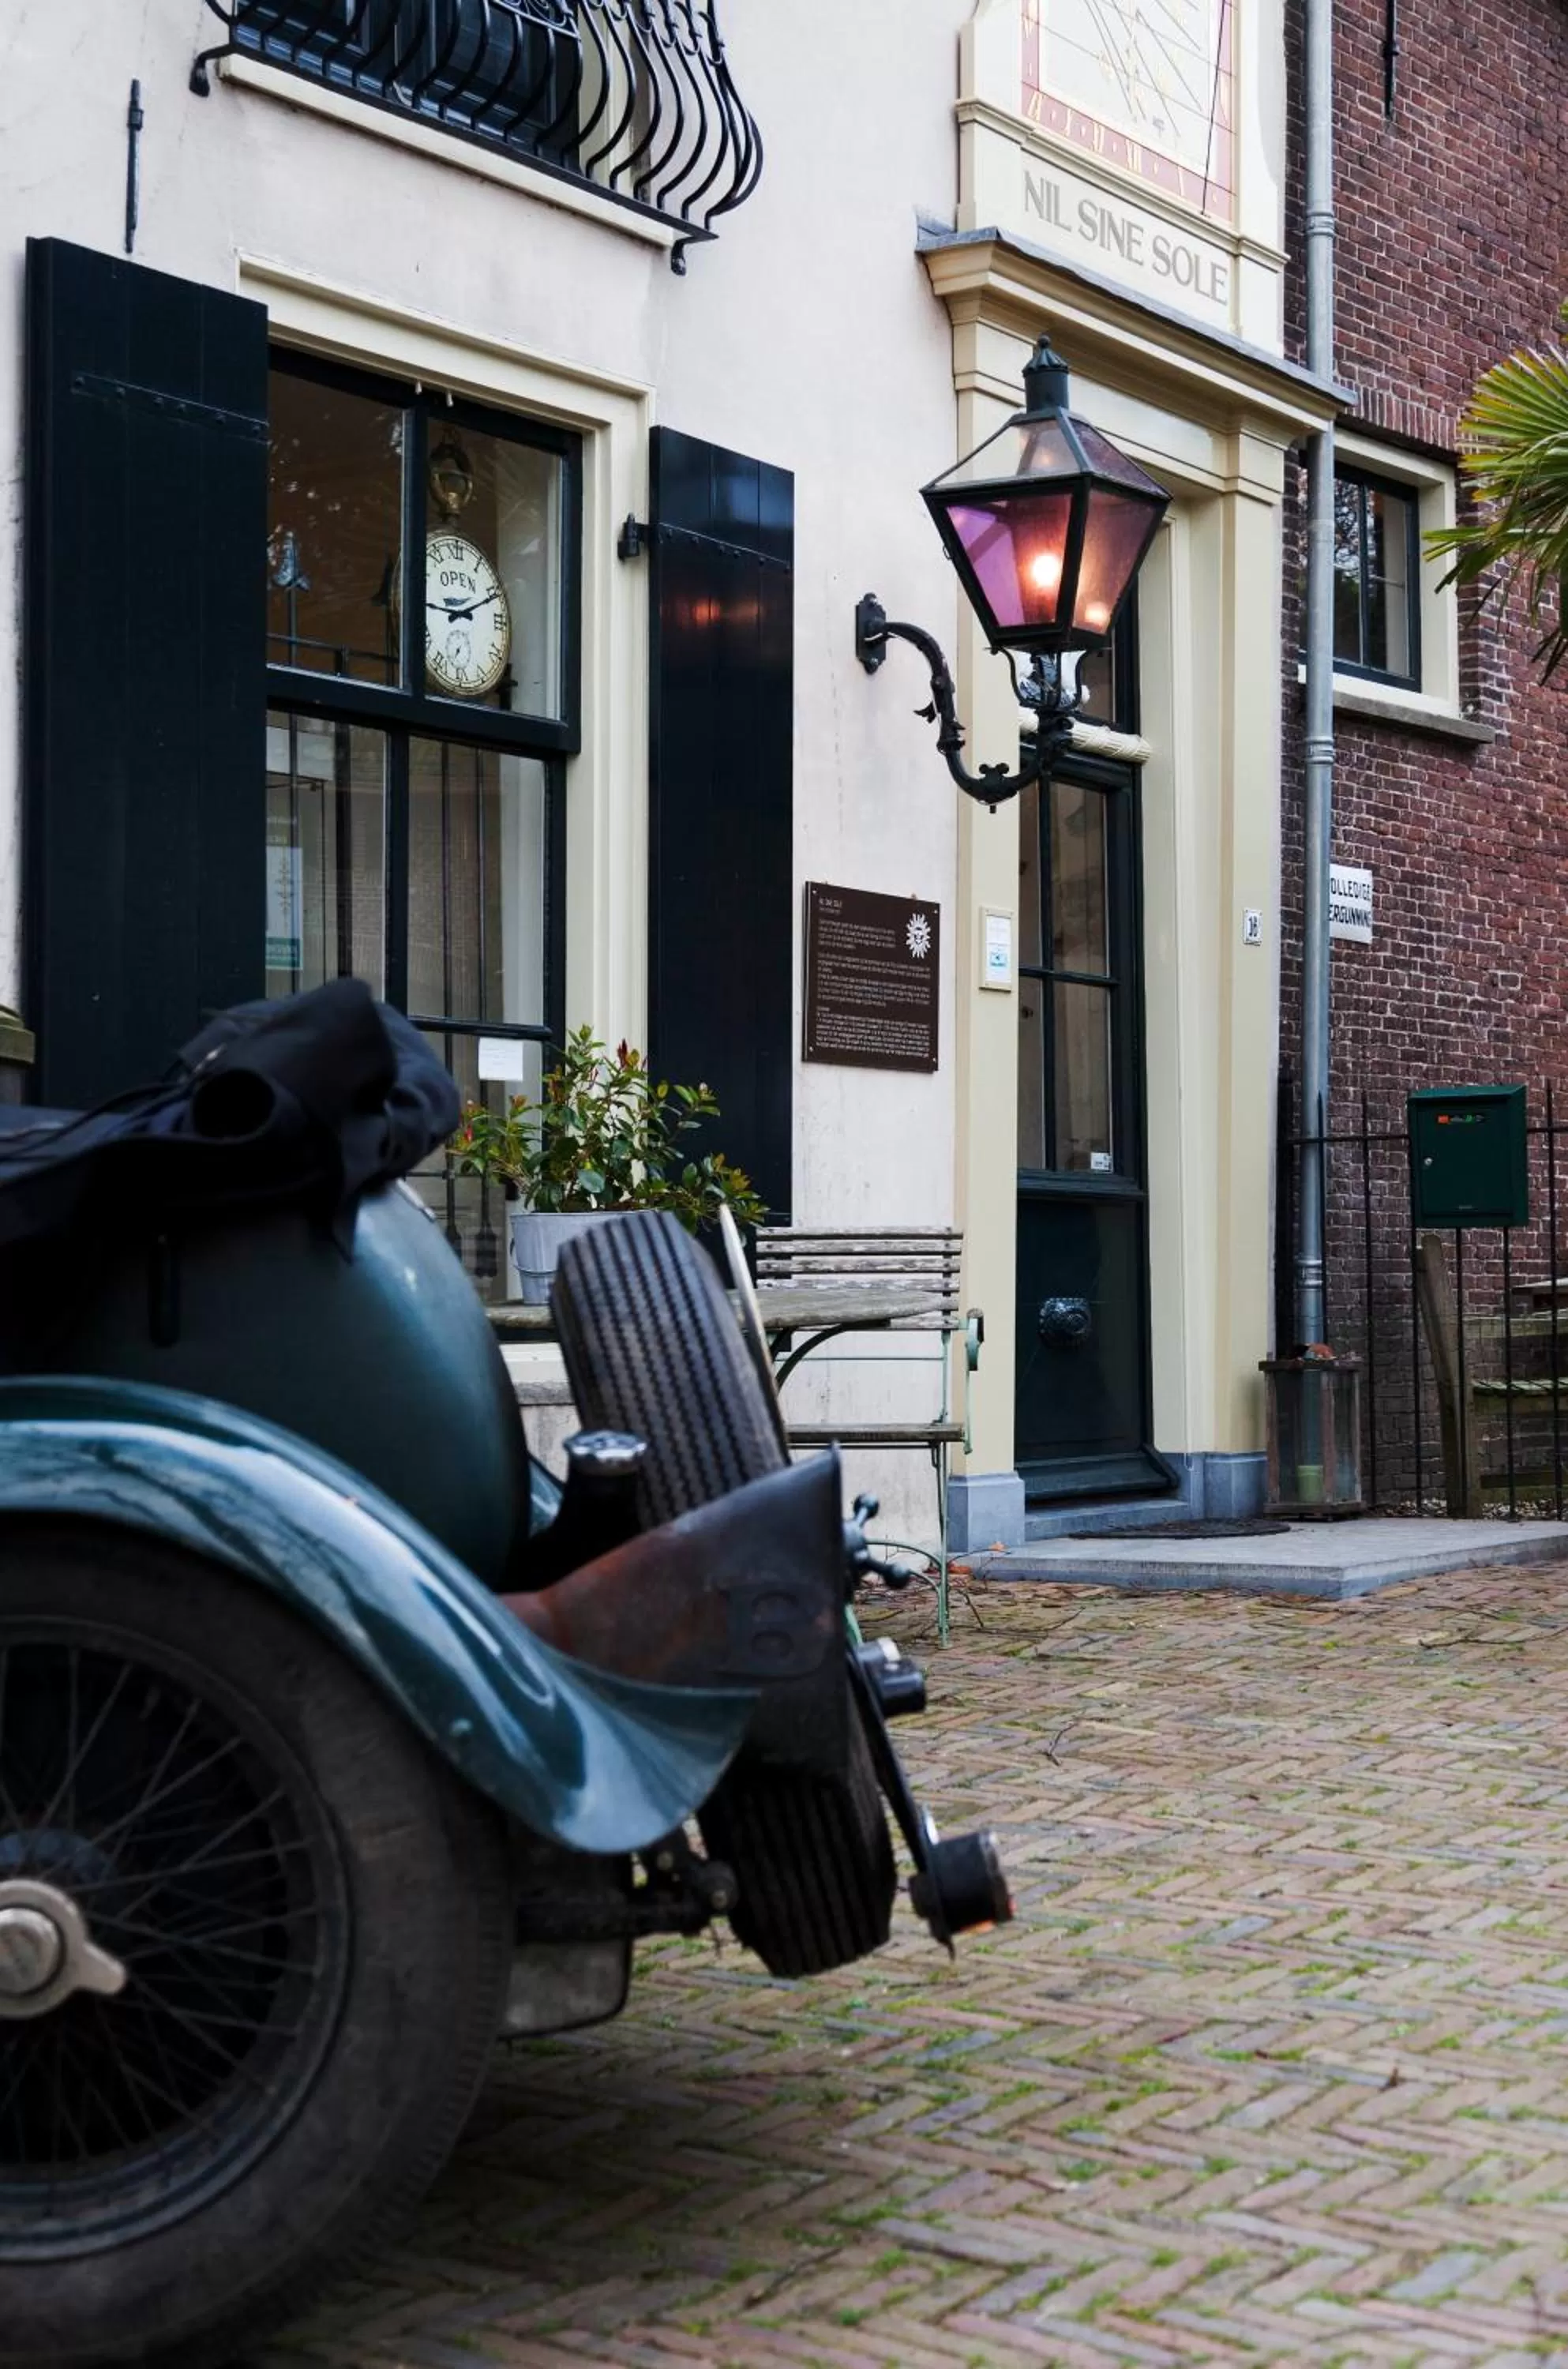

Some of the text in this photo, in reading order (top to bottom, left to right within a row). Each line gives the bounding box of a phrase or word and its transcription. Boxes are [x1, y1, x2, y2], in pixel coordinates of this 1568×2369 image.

[1025, 171, 1228, 306] NIL SINE SOLE
[440, 570, 476, 594] OPEN
[1330, 877, 1371, 901] OLLEDIGE
[1329, 904, 1371, 927] ERGUNNING
